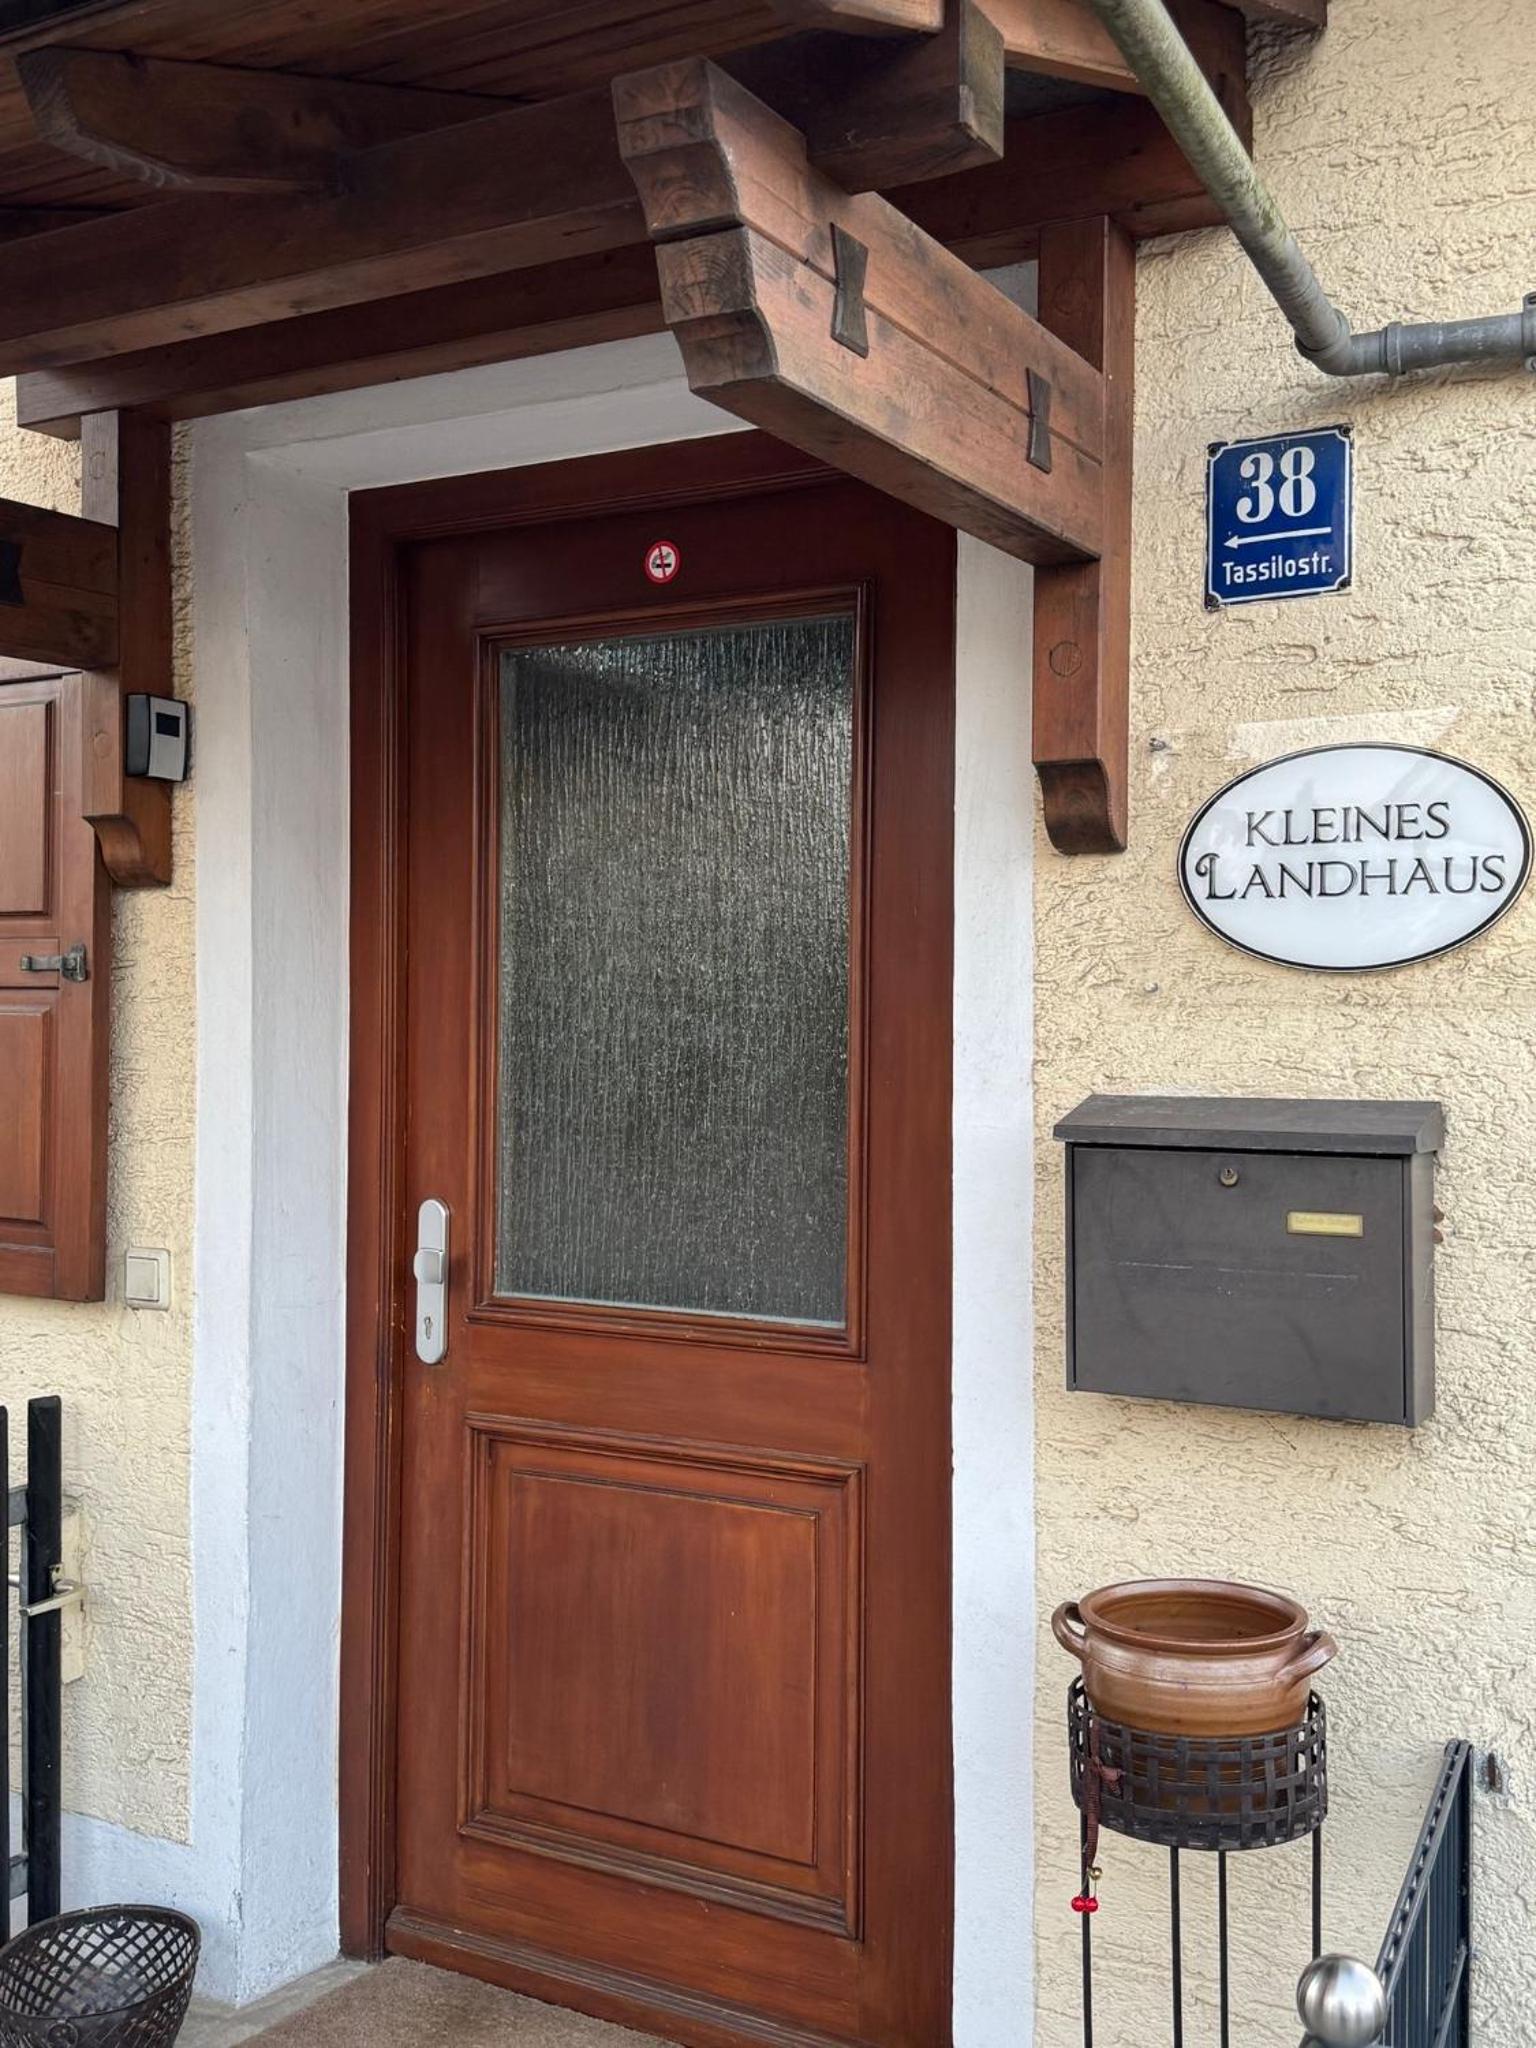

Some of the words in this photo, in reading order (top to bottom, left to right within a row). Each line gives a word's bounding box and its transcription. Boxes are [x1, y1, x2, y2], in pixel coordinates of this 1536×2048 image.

[1236, 446, 1316, 523] 38
[1222, 552, 1333, 585] Tassilostr.
[1245, 801, 1450, 847] KLEINES
[1195, 852, 1506, 900] LANDHAUS
